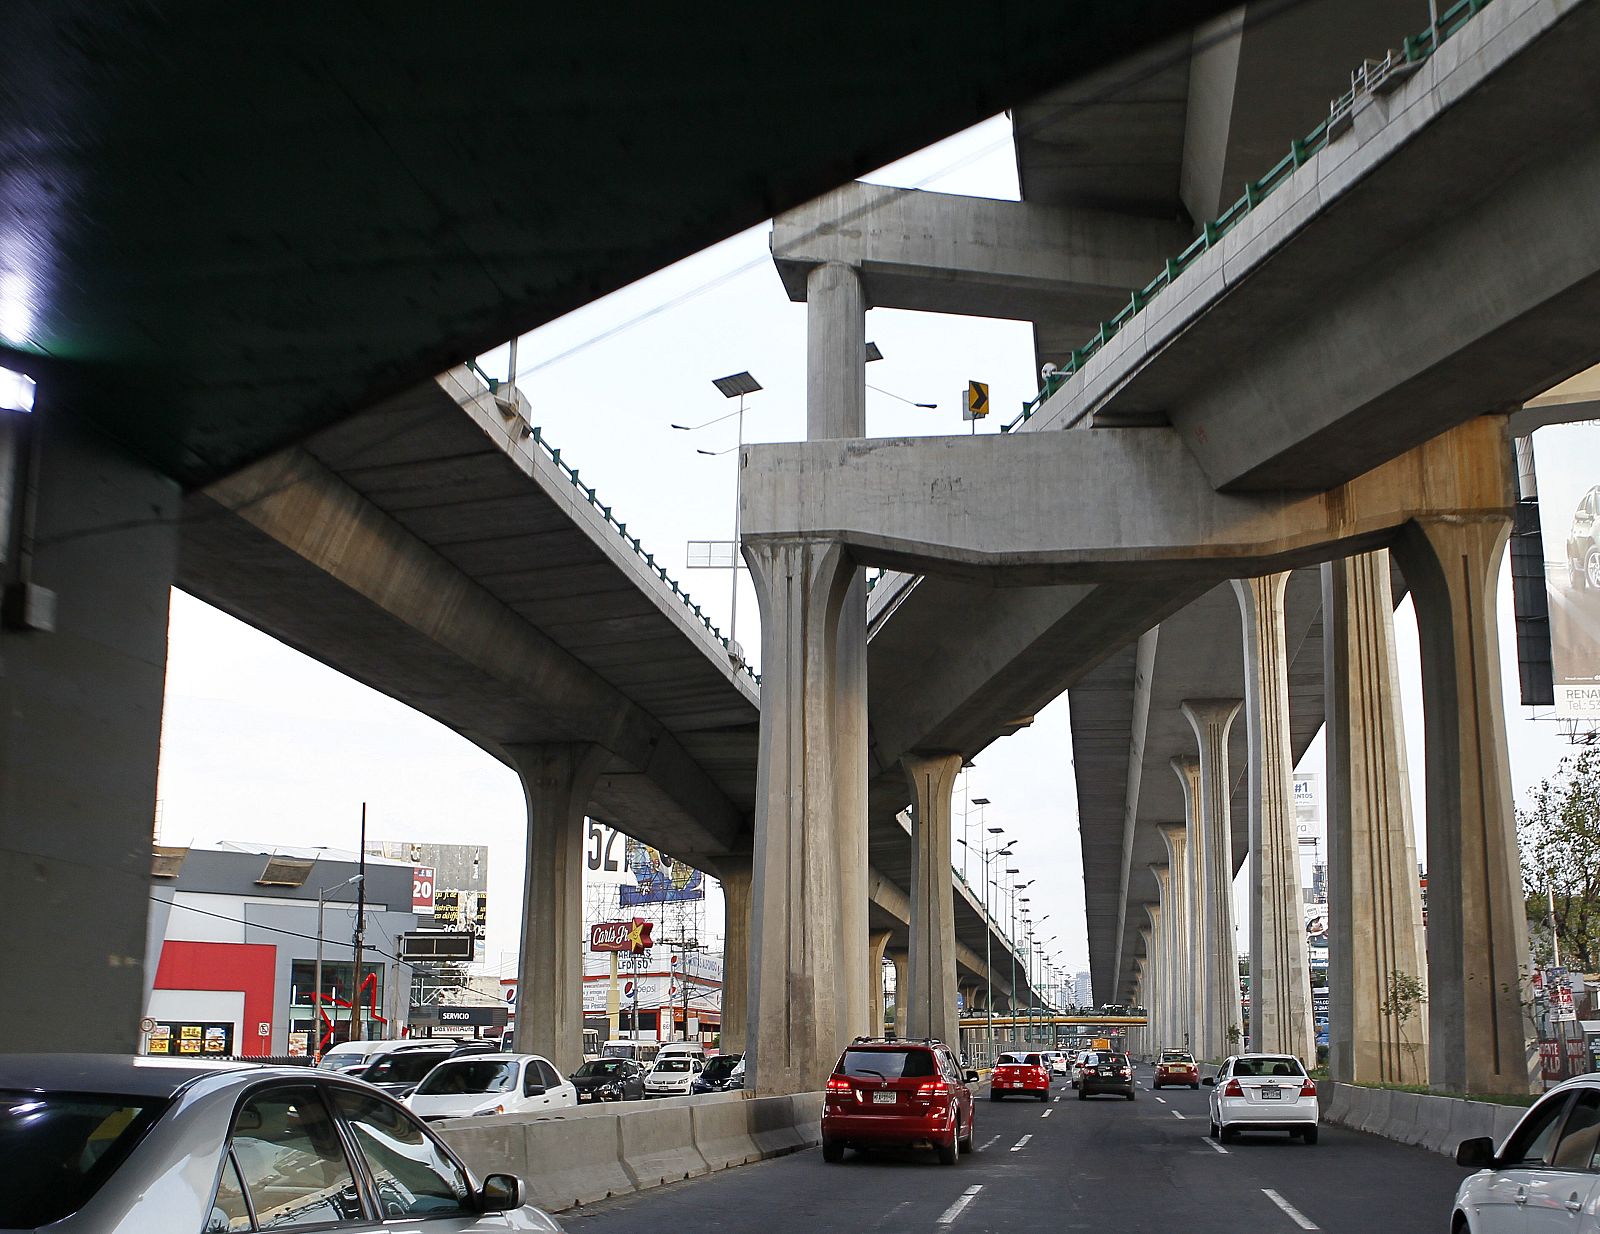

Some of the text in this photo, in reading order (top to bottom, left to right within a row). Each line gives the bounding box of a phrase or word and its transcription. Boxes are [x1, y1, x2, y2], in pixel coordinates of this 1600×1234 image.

[413, 881, 431, 898] 20
[593, 925, 630, 945] Carl's Jr.
